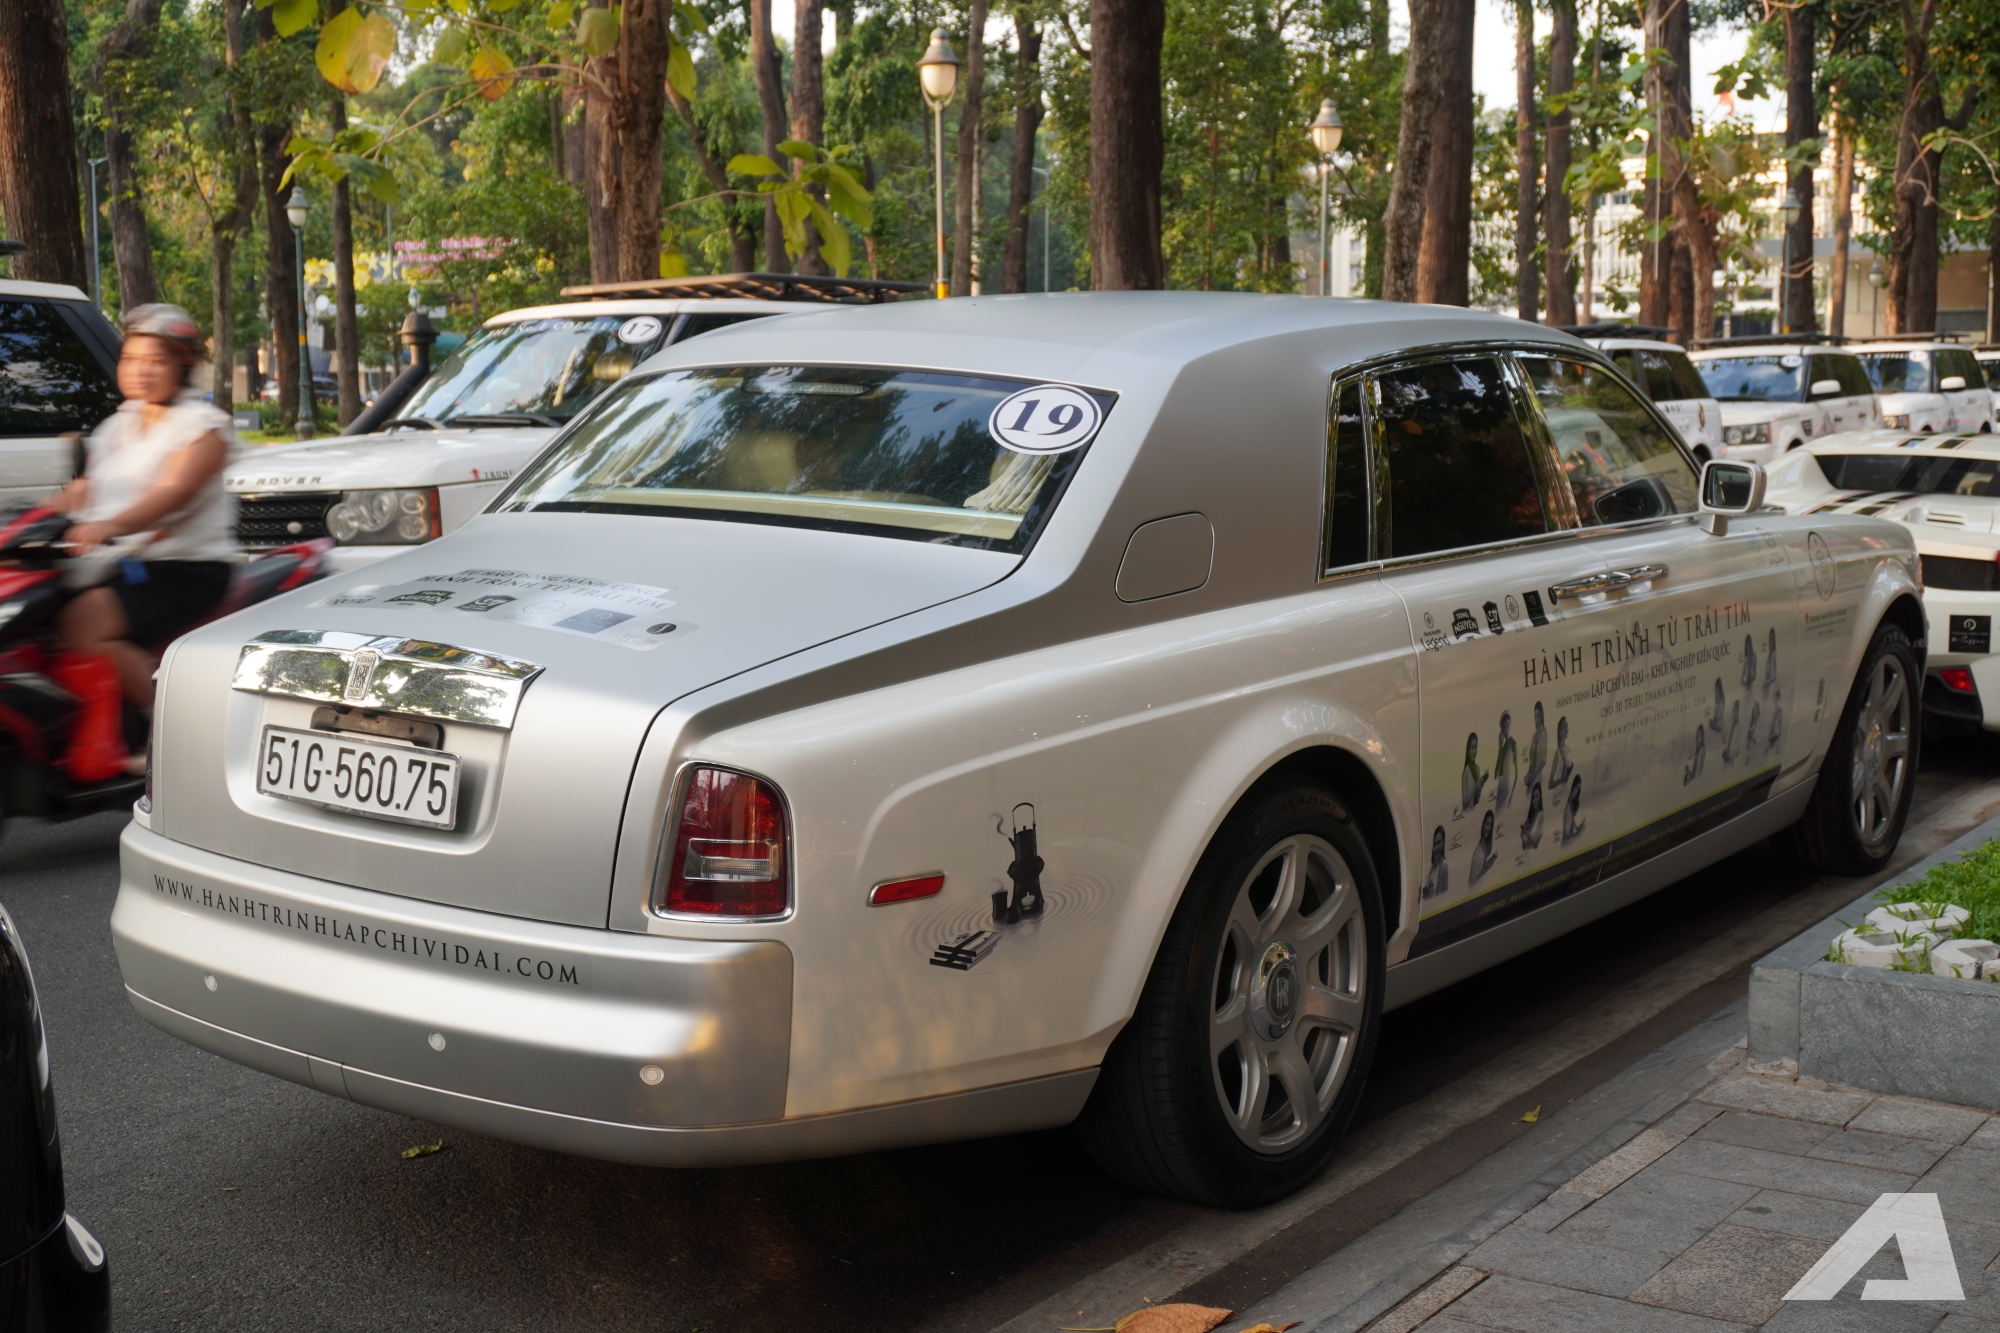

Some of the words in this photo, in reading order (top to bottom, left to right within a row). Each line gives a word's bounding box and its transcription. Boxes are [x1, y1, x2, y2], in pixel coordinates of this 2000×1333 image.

[625, 322, 656, 337] 17
[1003, 399, 1084, 436] 19
[256, 477, 321, 486] ROVER
[573, 586, 622, 600] TRÁI
[624, 595, 668, 610] TIM
[1420, 633, 1451, 652] Legend
[1522, 646, 1584, 689] HÀNH
[1591, 628, 1650, 669] TRÌNH
[1657, 614, 1678, 650] TỪ
[1684, 604, 1719, 642] TRÁI
[1724, 600, 1751, 630] TIM
[1591, 679, 1605, 700] LẬP
[1600, 705, 1614, 718] CHO
[1615, 701, 1623, 714] 30
[1645, 686, 1667, 704] THANH
[266, 735, 451, 816] 51G-560.75
[153, 874, 580, 986] WWW.HANHTRINHLAPCHIVIDAI.COM
